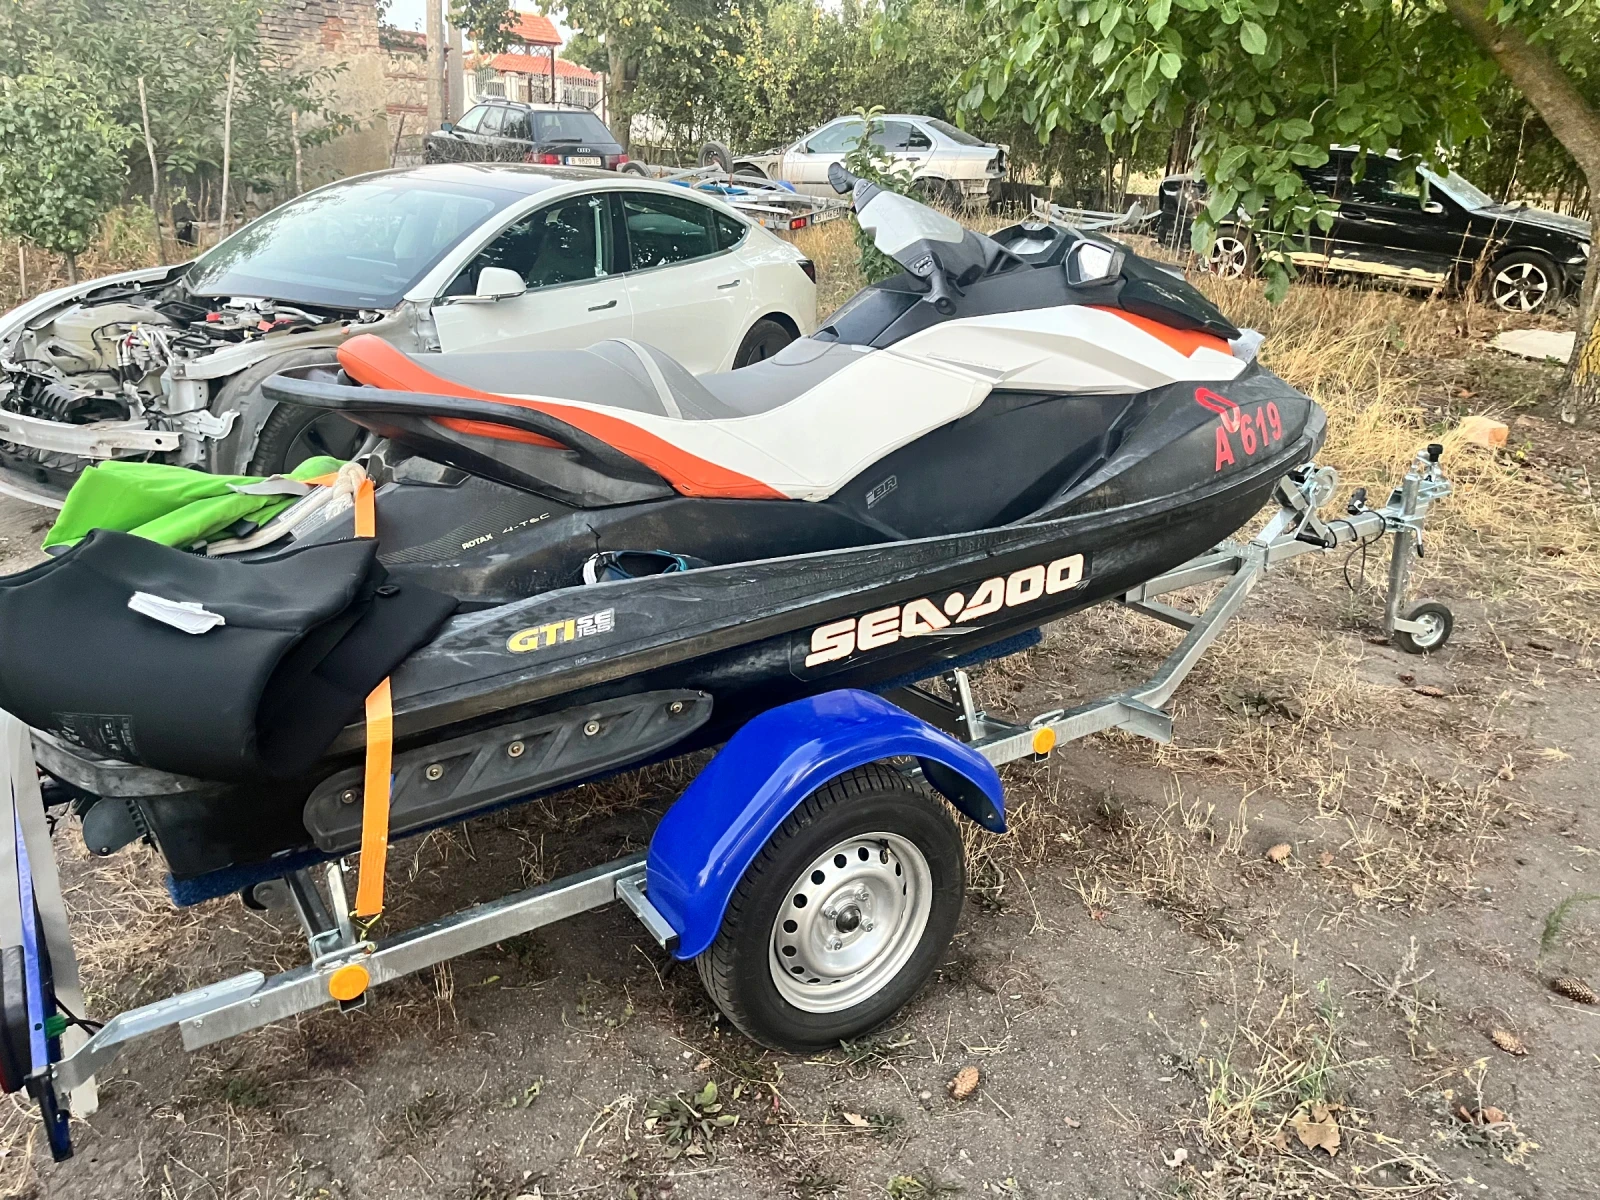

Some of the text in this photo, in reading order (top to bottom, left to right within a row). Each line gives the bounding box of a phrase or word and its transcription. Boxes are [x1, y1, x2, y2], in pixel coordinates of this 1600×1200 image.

[461, 532, 494, 551] ROTAX
[507, 611, 612, 653] GTI SE
[576, 623, 615, 639] 155
